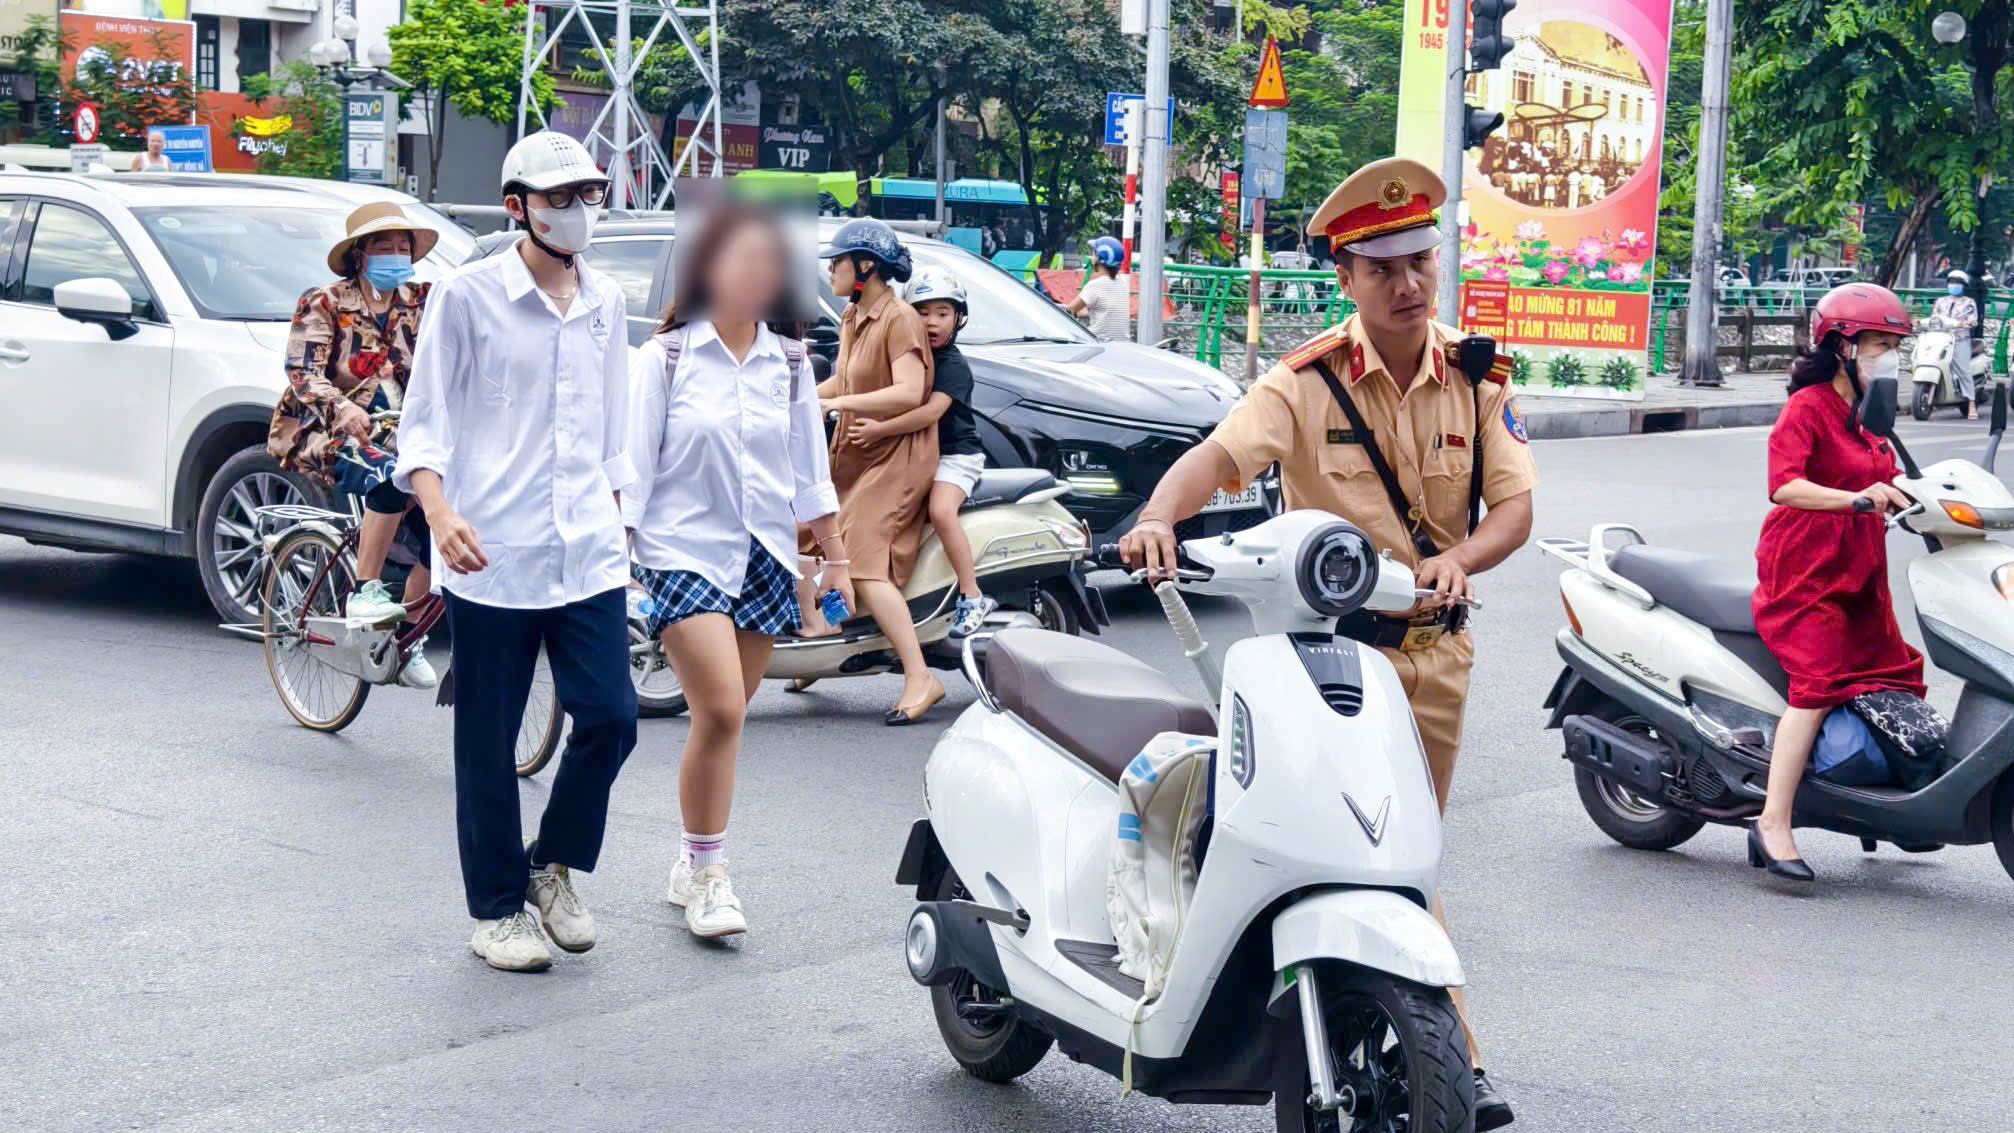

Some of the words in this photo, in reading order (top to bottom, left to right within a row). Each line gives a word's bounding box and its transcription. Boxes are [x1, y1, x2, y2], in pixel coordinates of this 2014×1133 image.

[1419, 32, 1443, 49] 1945
[349, 102, 373, 116] BIDV
[778, 148, 810, 168] VIP
[1526, 293, 1565, 316] MỪNG
[1567, 298, 1582, 316] 81
[1586, 298, 1617, 318] NĂM
[1518, 316, 1545, 339] TÁM
[1548, 318, 1589, 341] THÀNH
[1592, 320, 1627, 343] CÔNG
[1308, 647, 1354, 657] VINFAST
[1612, 652, 1661, 678] Spacy
